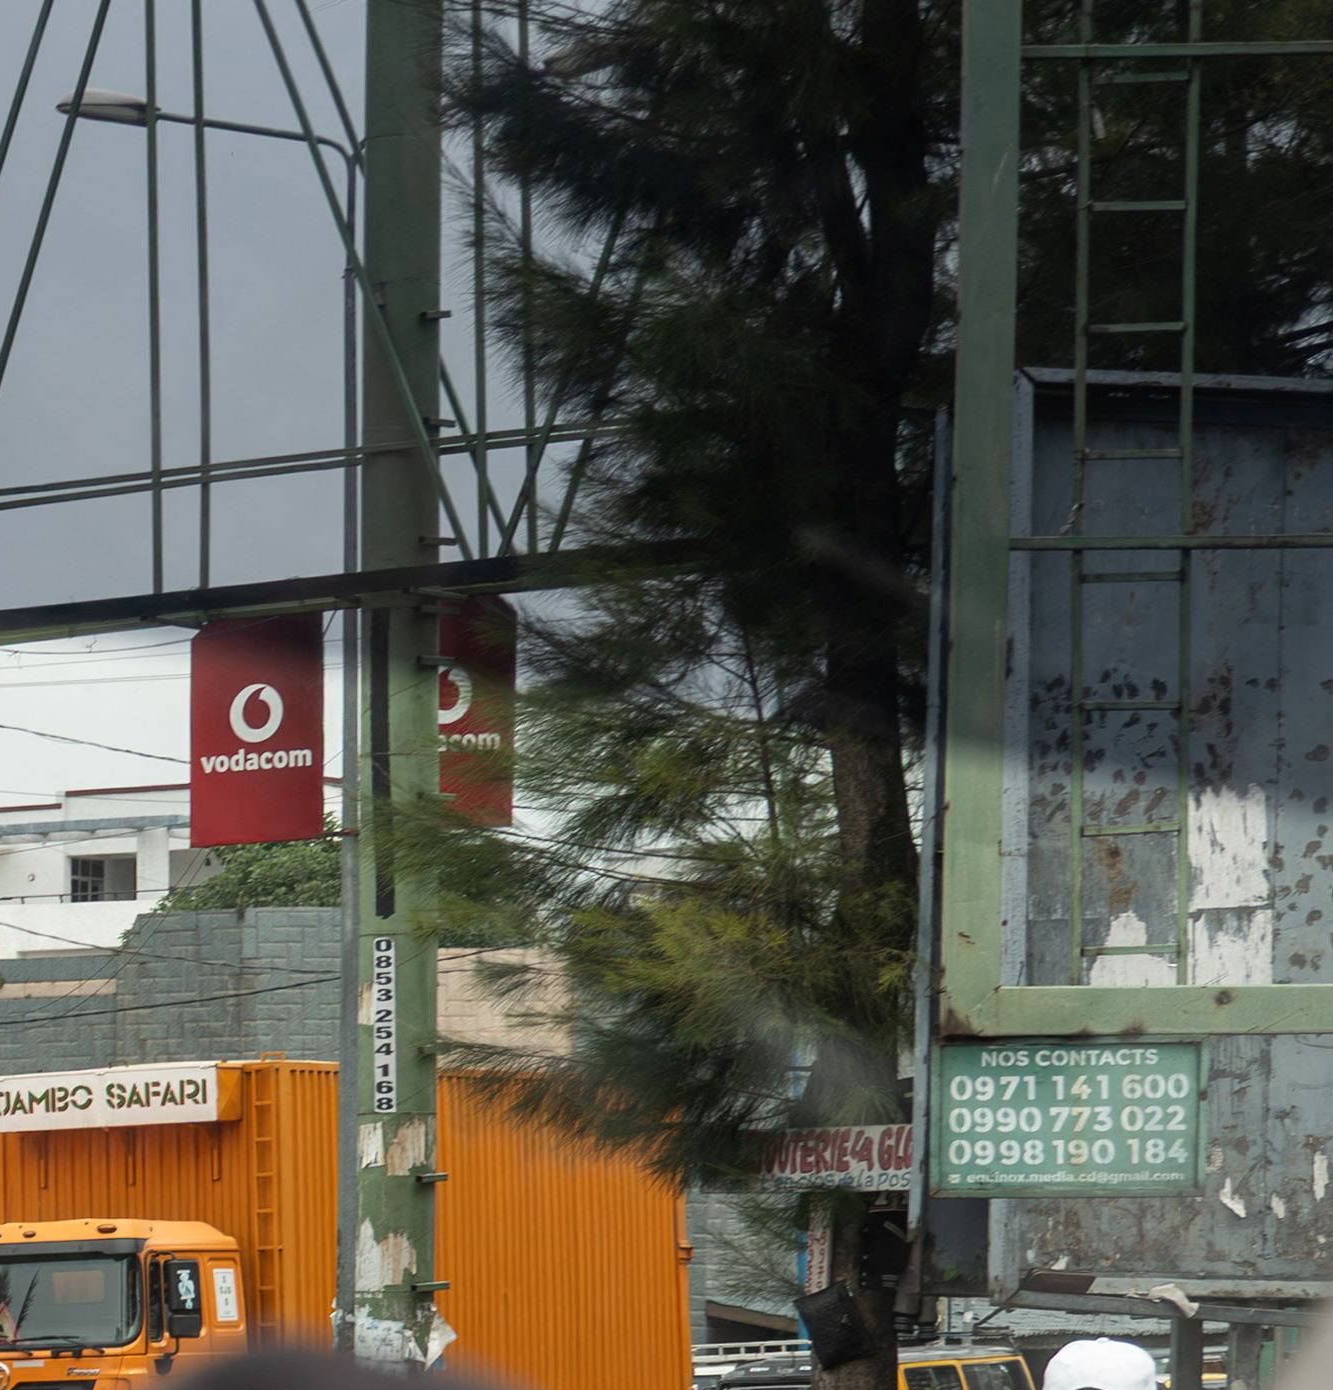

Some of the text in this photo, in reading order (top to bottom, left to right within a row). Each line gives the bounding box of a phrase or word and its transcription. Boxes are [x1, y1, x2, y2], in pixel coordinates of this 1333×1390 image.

[200, 748, 313, 773] vodacom
[375, 938, 394, 1110] 0853 254 168
[981, 1049, 1159, 1067] NOS CONTACTS
[106, 1079, 207, 1109] SAFARI
[950, 1074, 1190, 1101] 0971 141 600
[949, 1105, 1187, 1133] 0990 773 022
[949, 1138, 1189, 1166] 0998 190 184
